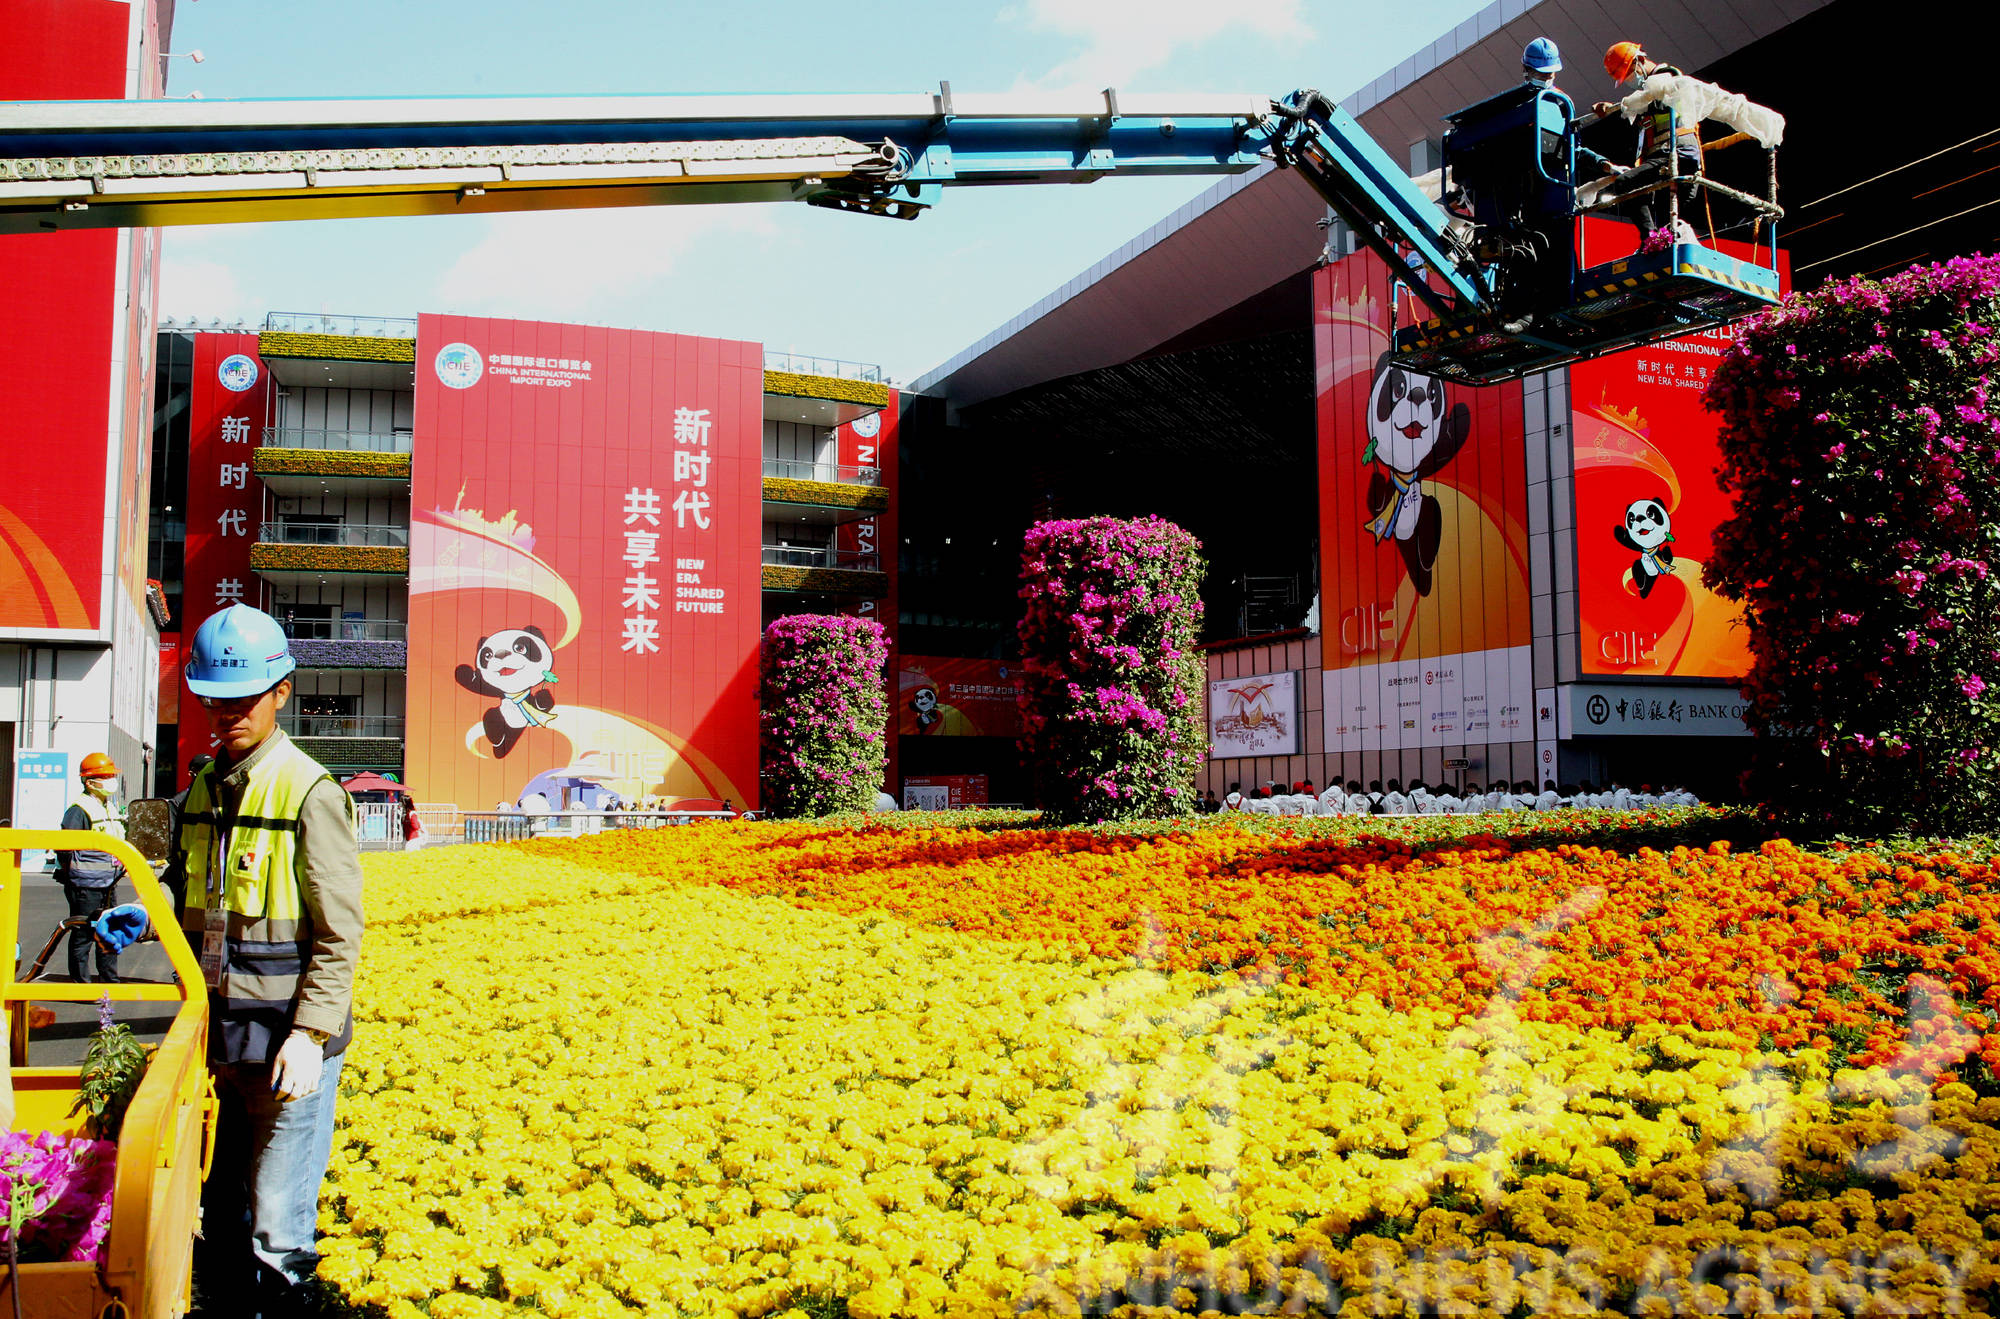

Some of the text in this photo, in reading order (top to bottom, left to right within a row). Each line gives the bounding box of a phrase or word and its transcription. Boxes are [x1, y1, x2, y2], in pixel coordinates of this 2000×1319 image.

[488, 366, 592, 381] CHINA INTERNATIONAL
[510, 376, 572, 389] IMPORT EXPO
[1637, 374, 1655, 384] NEW
[1658, 376, 1673, 386] ERA
[1675, 379, 1705, 390] SHARED
[671, 406, 712, 530] 新时代
[620, 486, 661, 655] 共享未来
[676, 558, 705, 570] NEW
[676, 572, 701, 584] ERA
[675, 586, 725, 600] SHARED
[675, 602, 725, 614] FUTURE
[1689, 703, 1728, 719] BANK
